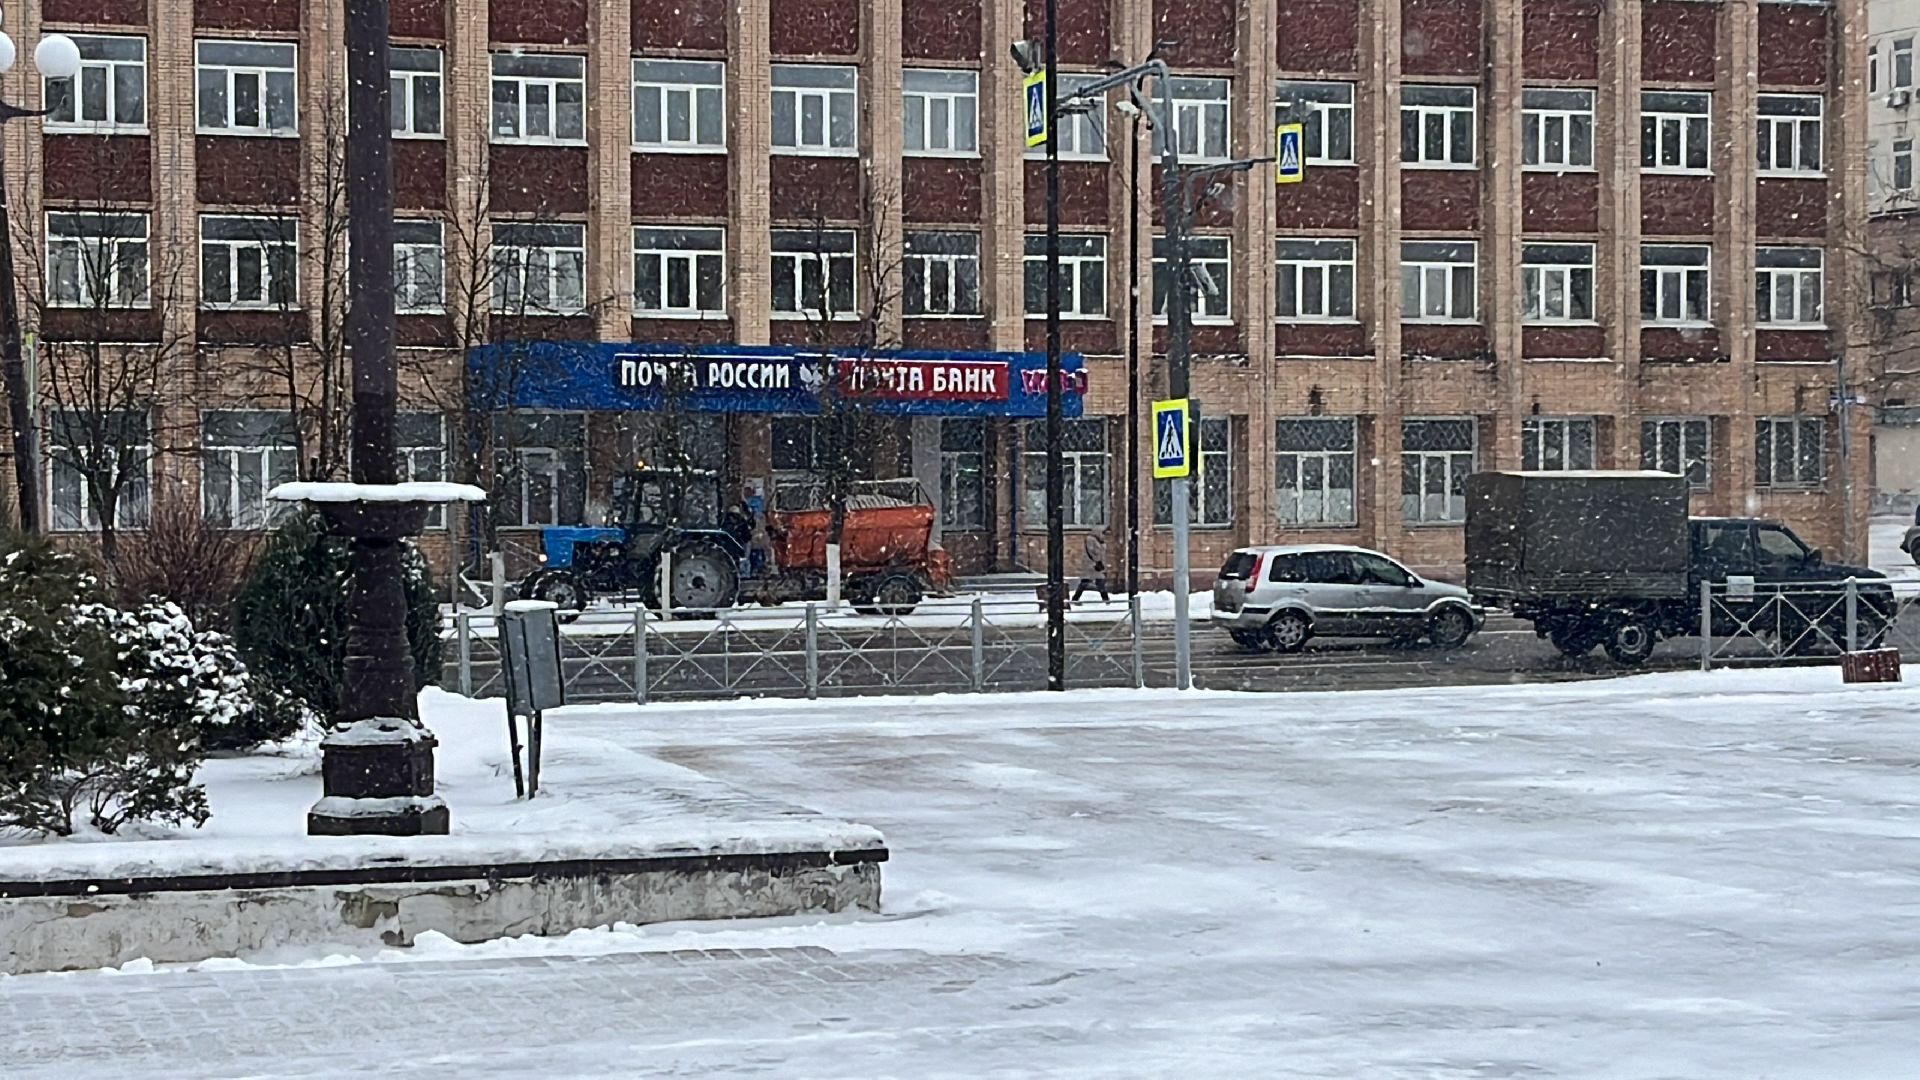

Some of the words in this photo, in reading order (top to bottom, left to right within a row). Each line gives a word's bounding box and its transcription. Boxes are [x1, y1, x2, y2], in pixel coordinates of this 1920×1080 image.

[621, 359, 699, 388] ПОЧА
[708, 361, 791, 389] РОССИИ
[932, 367, 997, 393] БАНК
